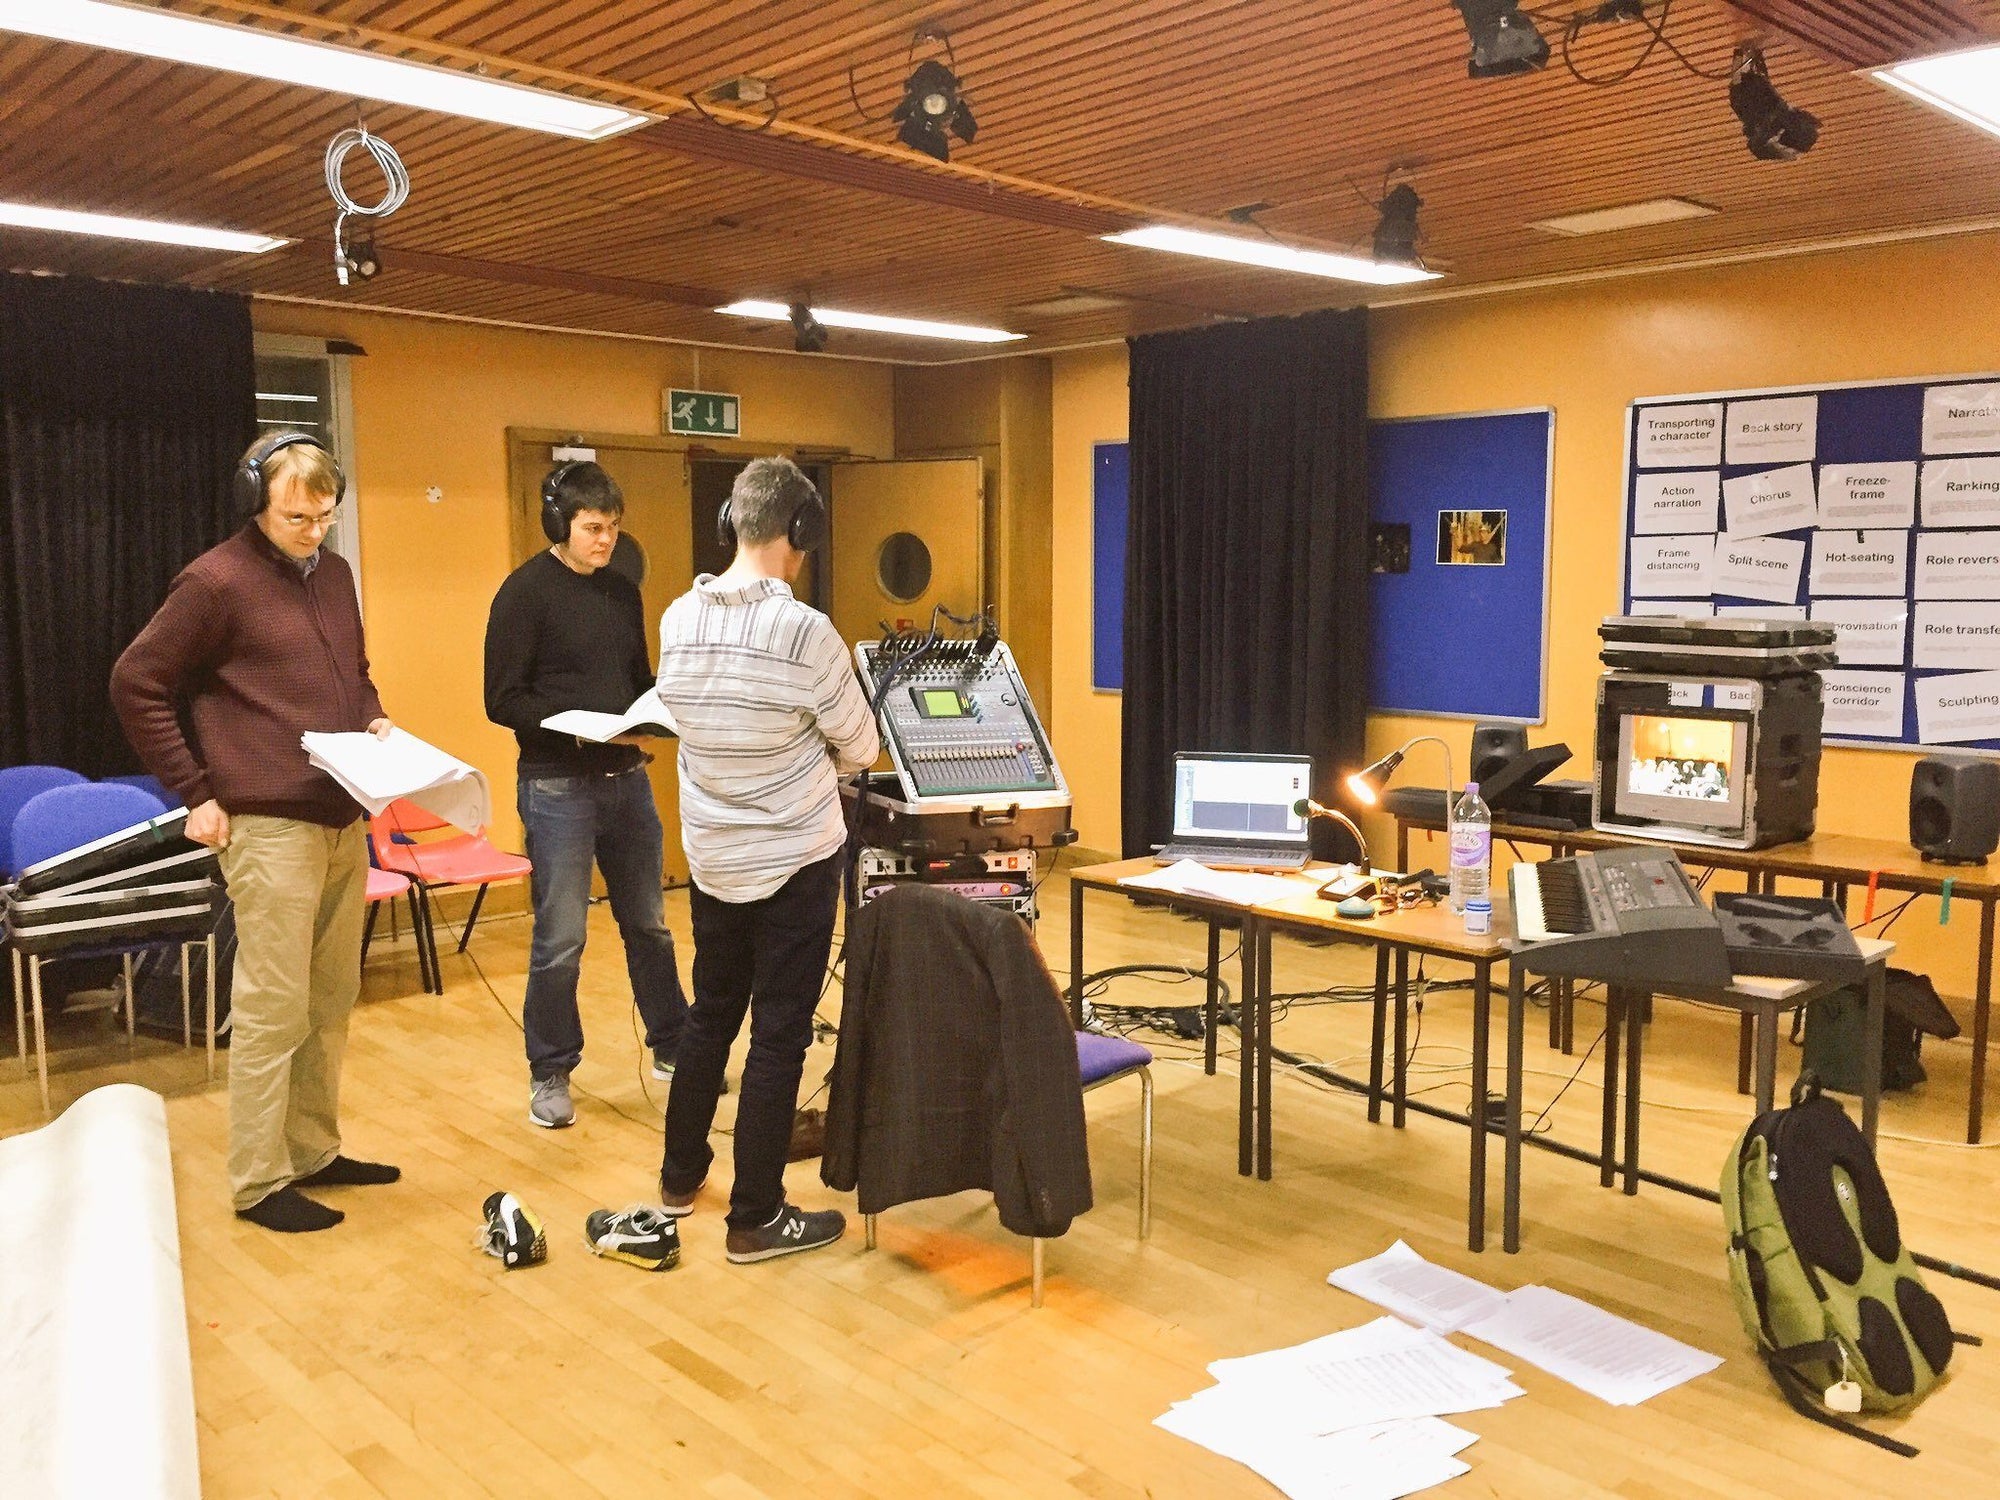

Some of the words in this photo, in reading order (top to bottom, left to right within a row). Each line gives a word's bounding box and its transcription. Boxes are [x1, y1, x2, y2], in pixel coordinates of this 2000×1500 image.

[1648, 418, 1716, 430] Transporting
[1742, 423, 1770, 433] Back
[1772, 421, 1804, 433] story
[1650, 434, 1657, 442] a
[1659, 430, 1711, 442] character
[1661, 486, 1695, 496] Action
[1946, 481, 2000, 493] Ranking
[1750, 489, 1792, 505] Chorus
[1850, 490, 1885, 500] frame
[1653, 498, 1701, 508] narration
[1657, 549, 1690, 558] Frame
[1825, 552, 1895, 565] Hot-seating
[1646, 560, 1700, 571] distancing
[1728, 553, 1753, 567] Split
[1755, 559, 1789, 570] scene
[1926, 555, 1955, 565] Role
[1925, 624, 1953, 635] Role
[1824, 682, 1892, 694] Conscience
[1832, 696, 1880, 706] corridor
[1938, 694, 2000, 708] Sculpting
